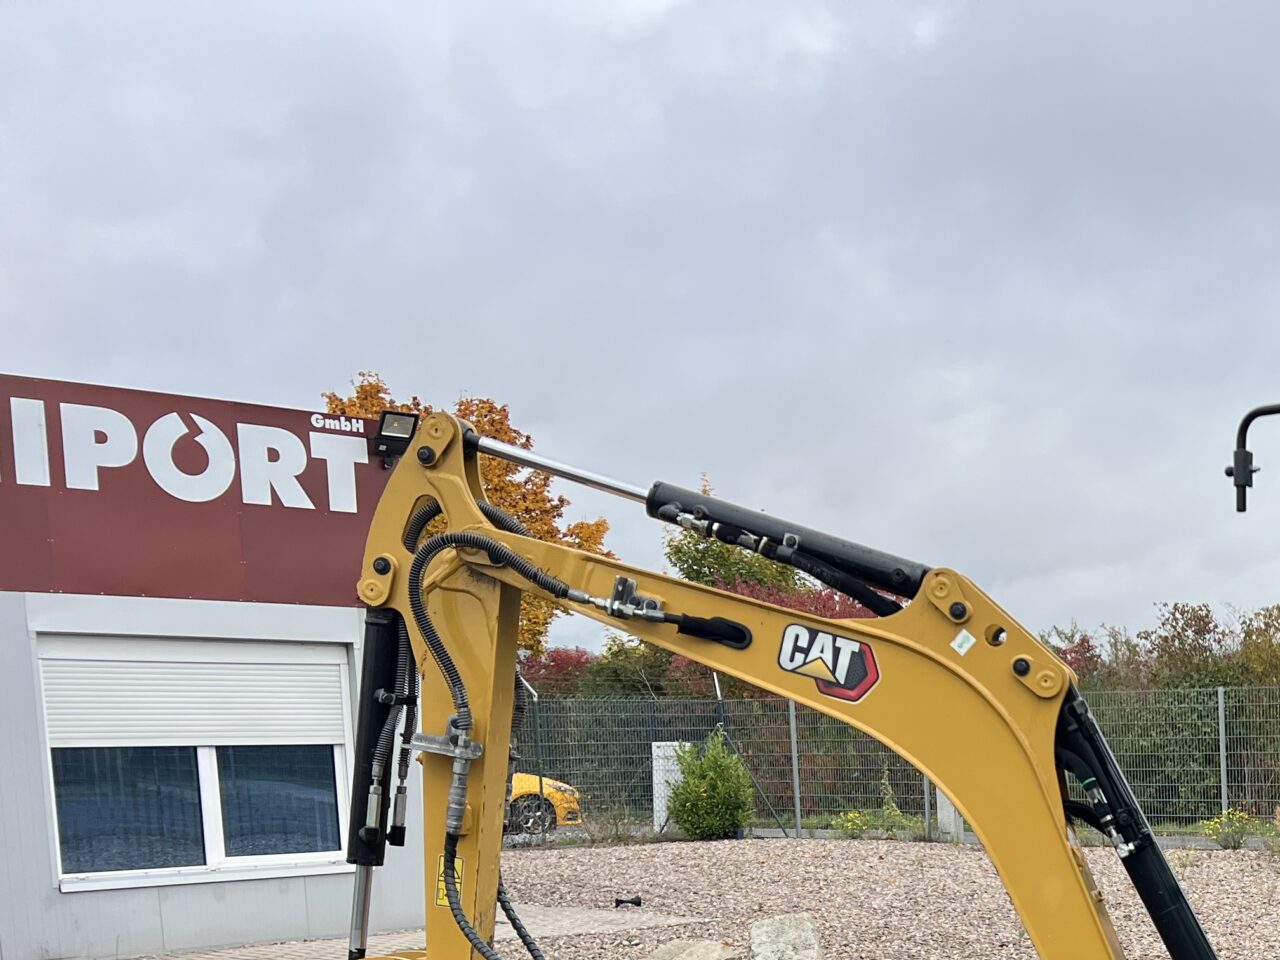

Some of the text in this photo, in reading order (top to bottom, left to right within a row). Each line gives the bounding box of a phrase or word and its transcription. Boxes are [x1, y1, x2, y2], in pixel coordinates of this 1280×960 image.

[310, 413, 365, 433] GmbH
[0, 396, 369, 513] IPORT
[779, 624, 860, 685] CAT
